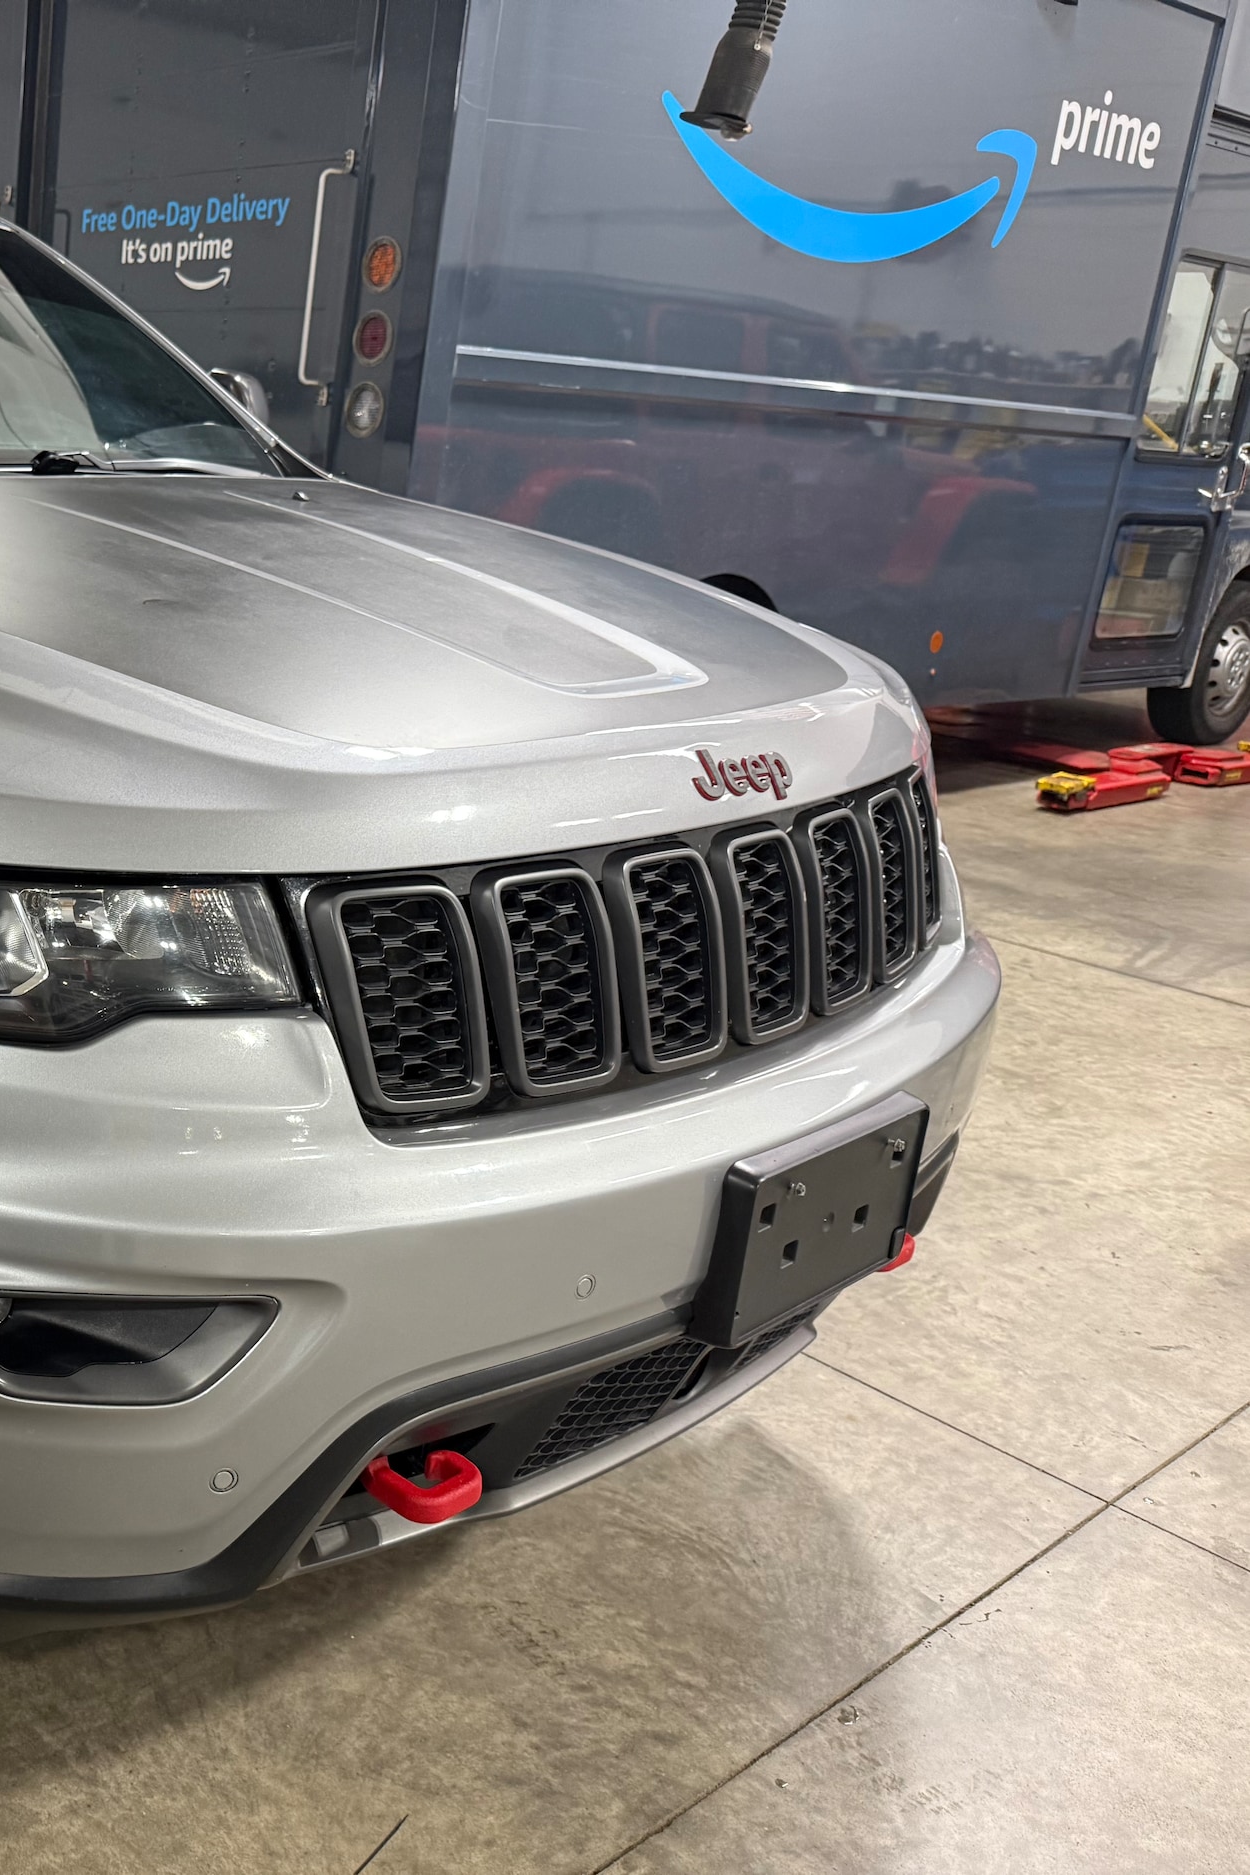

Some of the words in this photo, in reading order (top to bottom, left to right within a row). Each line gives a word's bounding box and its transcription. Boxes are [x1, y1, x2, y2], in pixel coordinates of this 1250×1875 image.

[1051, 90, 1161, 169] prime
[81, 208, 117, 234] Free
[121, 201, 203, 233] One-Day
[205, 192, 290, 227] Delivery
[121, 238, 147, 265] It's
[149, 240, 172, 262] on
[174, 232, 234, 269] prime
[691, 749, 793, 801] Jeep
